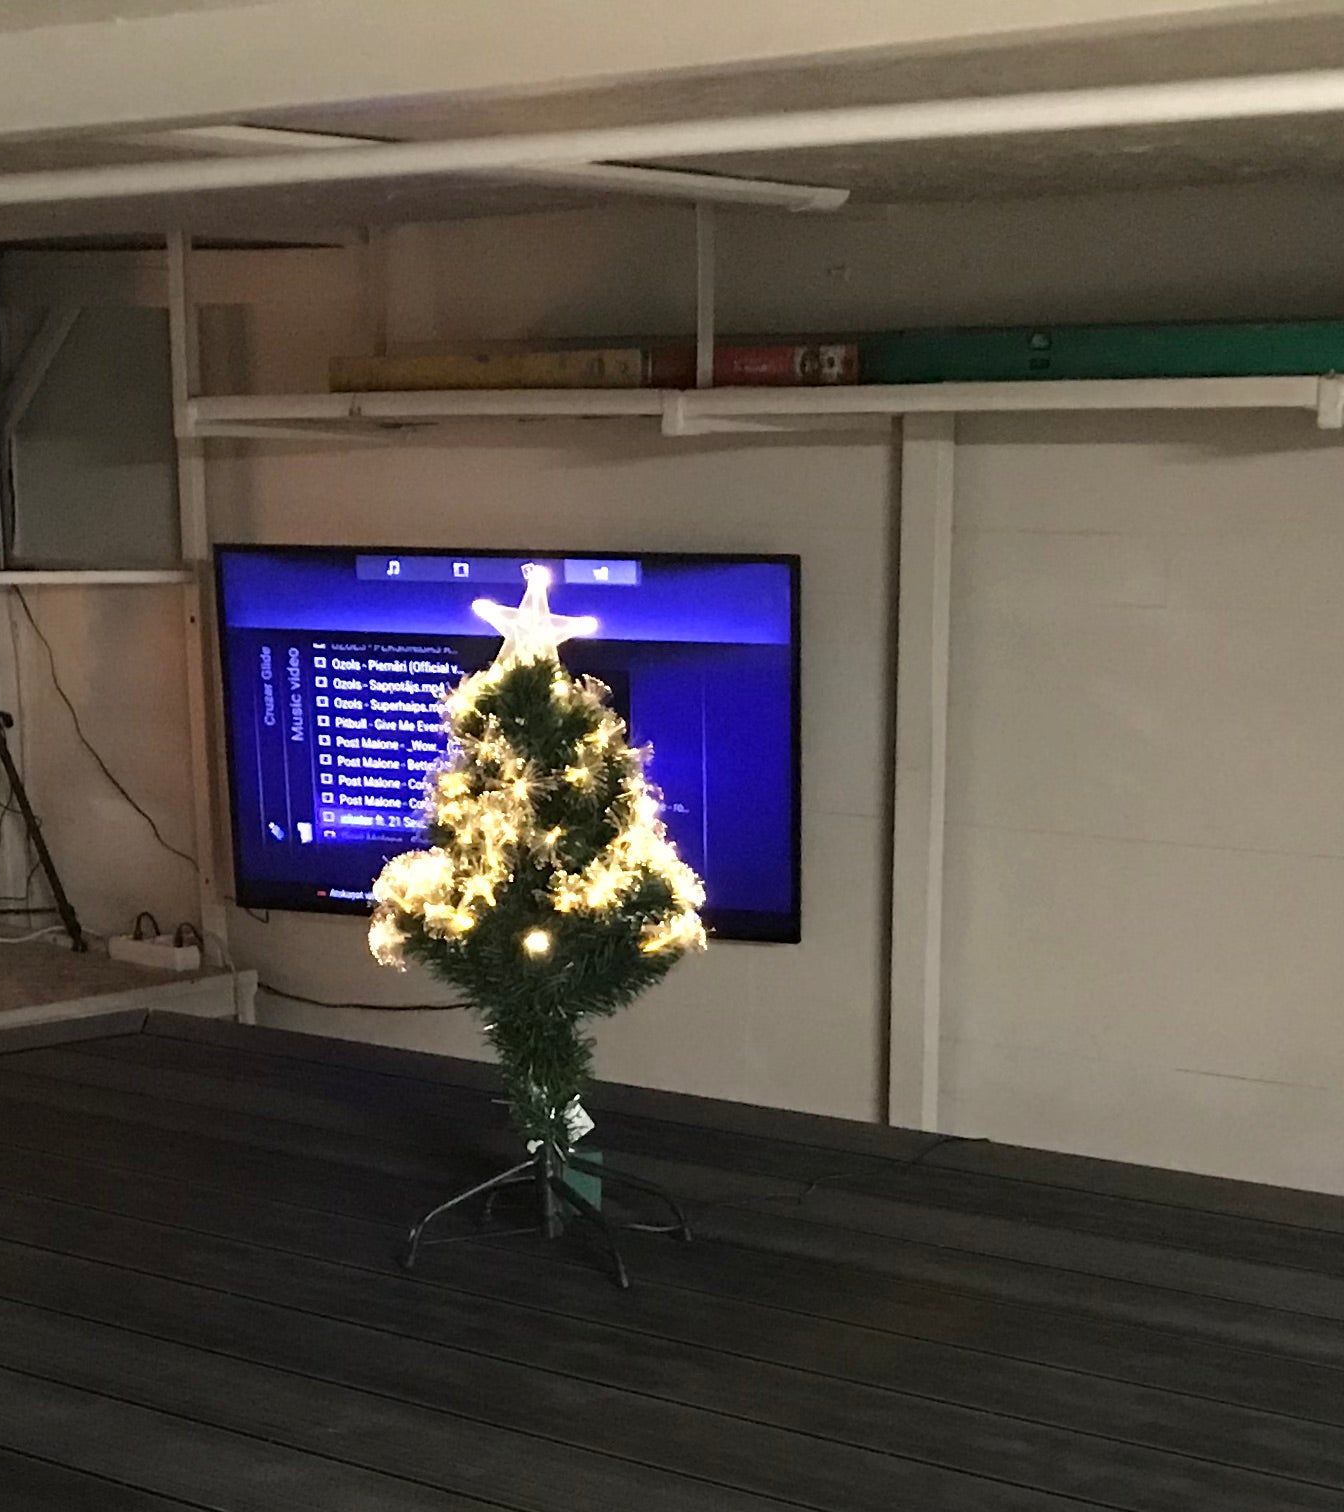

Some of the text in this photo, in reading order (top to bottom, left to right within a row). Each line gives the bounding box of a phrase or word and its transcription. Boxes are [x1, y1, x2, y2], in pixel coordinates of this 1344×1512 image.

[286, 647, 304, 741] Music video
[374, 719, 397, 731] Give
[398, 720, 416, 732] Me
[336, 736, 360, 749] Post
[361, 737, 399, 750] Malone
[337, 755, 361, 768] Post
[362, 757, 400, 769] Malone
[338, 775, 362, 787] Post
[363, 776, 401, 789] Malone
[339, 794, 363, 805] Post
[364, 795, 402, 808] Malone
